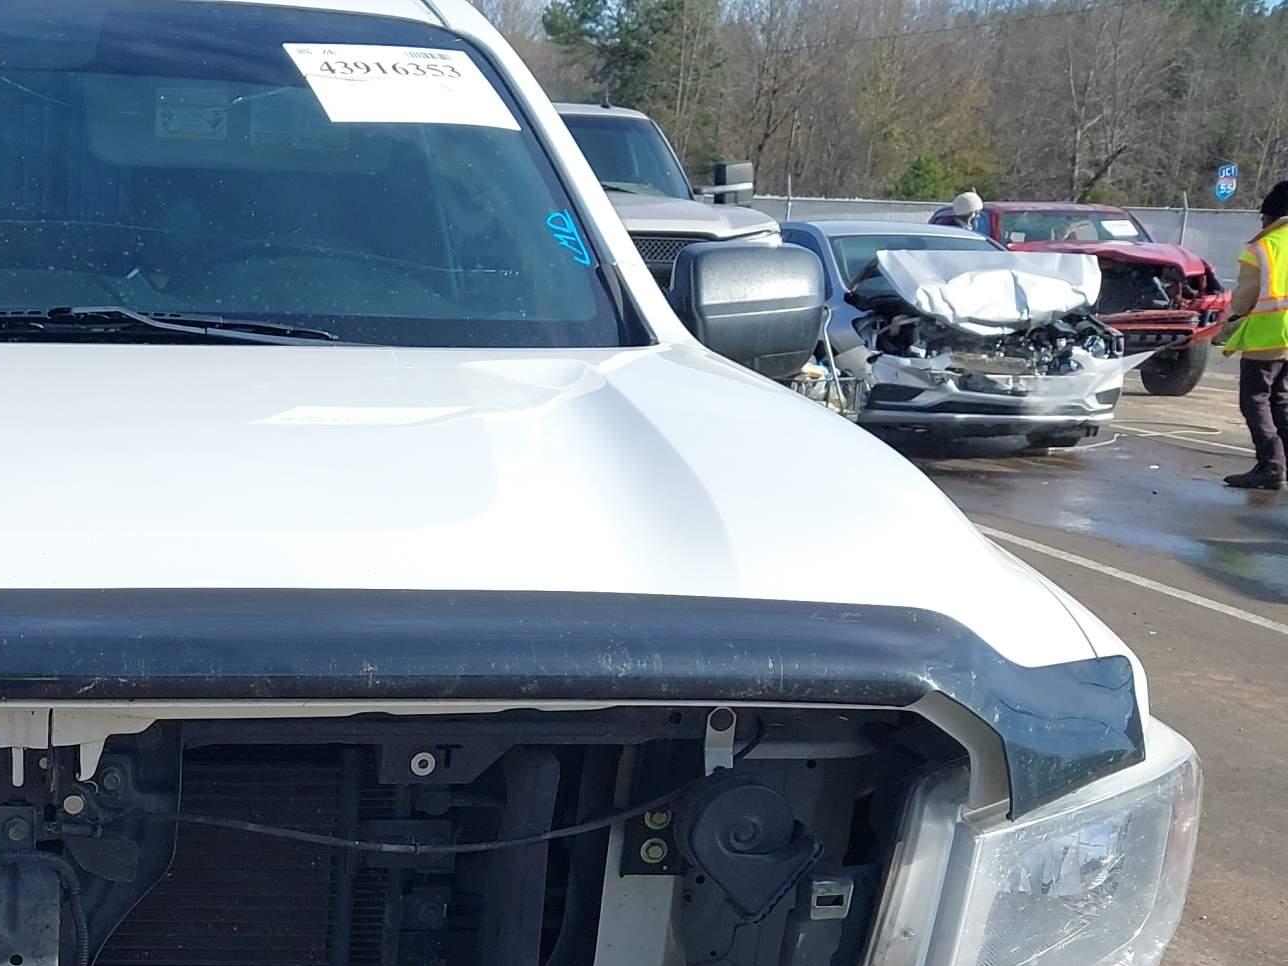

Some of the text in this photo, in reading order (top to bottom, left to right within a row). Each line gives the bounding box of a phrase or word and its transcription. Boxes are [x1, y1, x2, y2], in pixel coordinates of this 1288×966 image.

[320, 60, 462, 79] 43916353
[1220, 165, 1236, 178] JCT
[1219, 183, 1233, 194] 55
